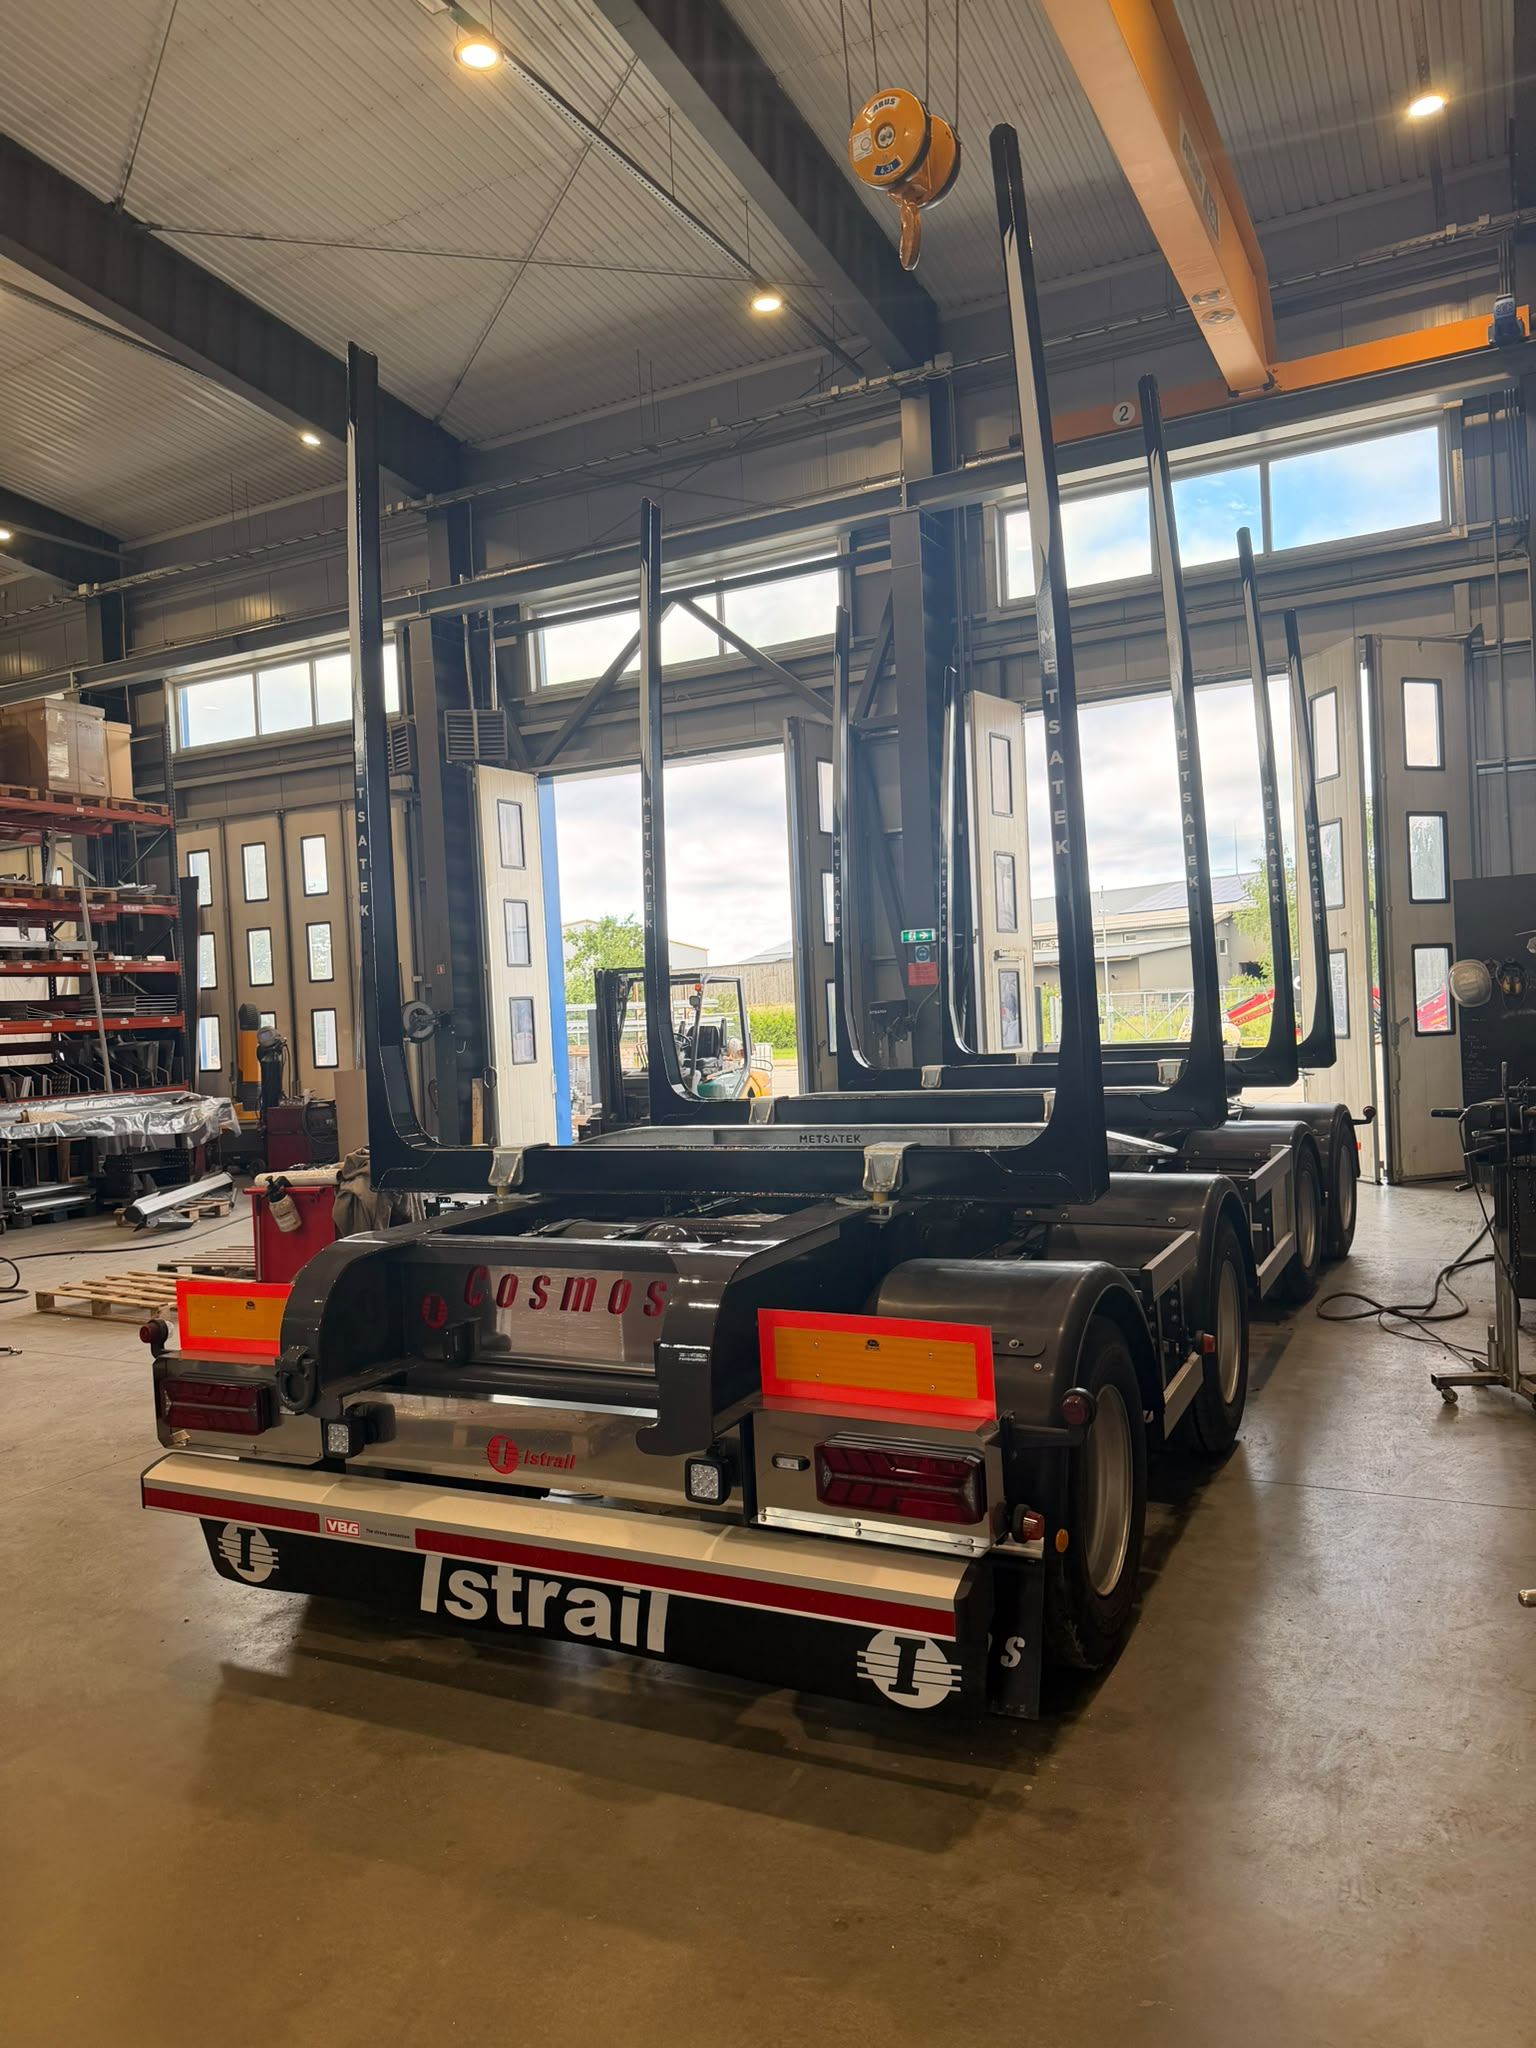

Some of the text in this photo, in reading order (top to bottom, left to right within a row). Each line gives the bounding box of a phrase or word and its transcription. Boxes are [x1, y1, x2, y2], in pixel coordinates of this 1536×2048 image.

[873, 98, 896, 112] ABUS
[1119, 406, 1129, 422] 2
[1040, 630, 1069, 854] METSATEK
[1176, 728, 1199, 887] METSATEK
[1263, 785, 1280, 903] METSATEK
[643, 797, 653, 928] METSATEK
[1307, 824, 1322, 920] METSATEK
[799, 1134, 862, 1144] METSATEK
[327, 1519, 359, 1535] VBG
[374, 1529, 387, 1537] strong
[420, 1554, 669, 1653] Istrail
